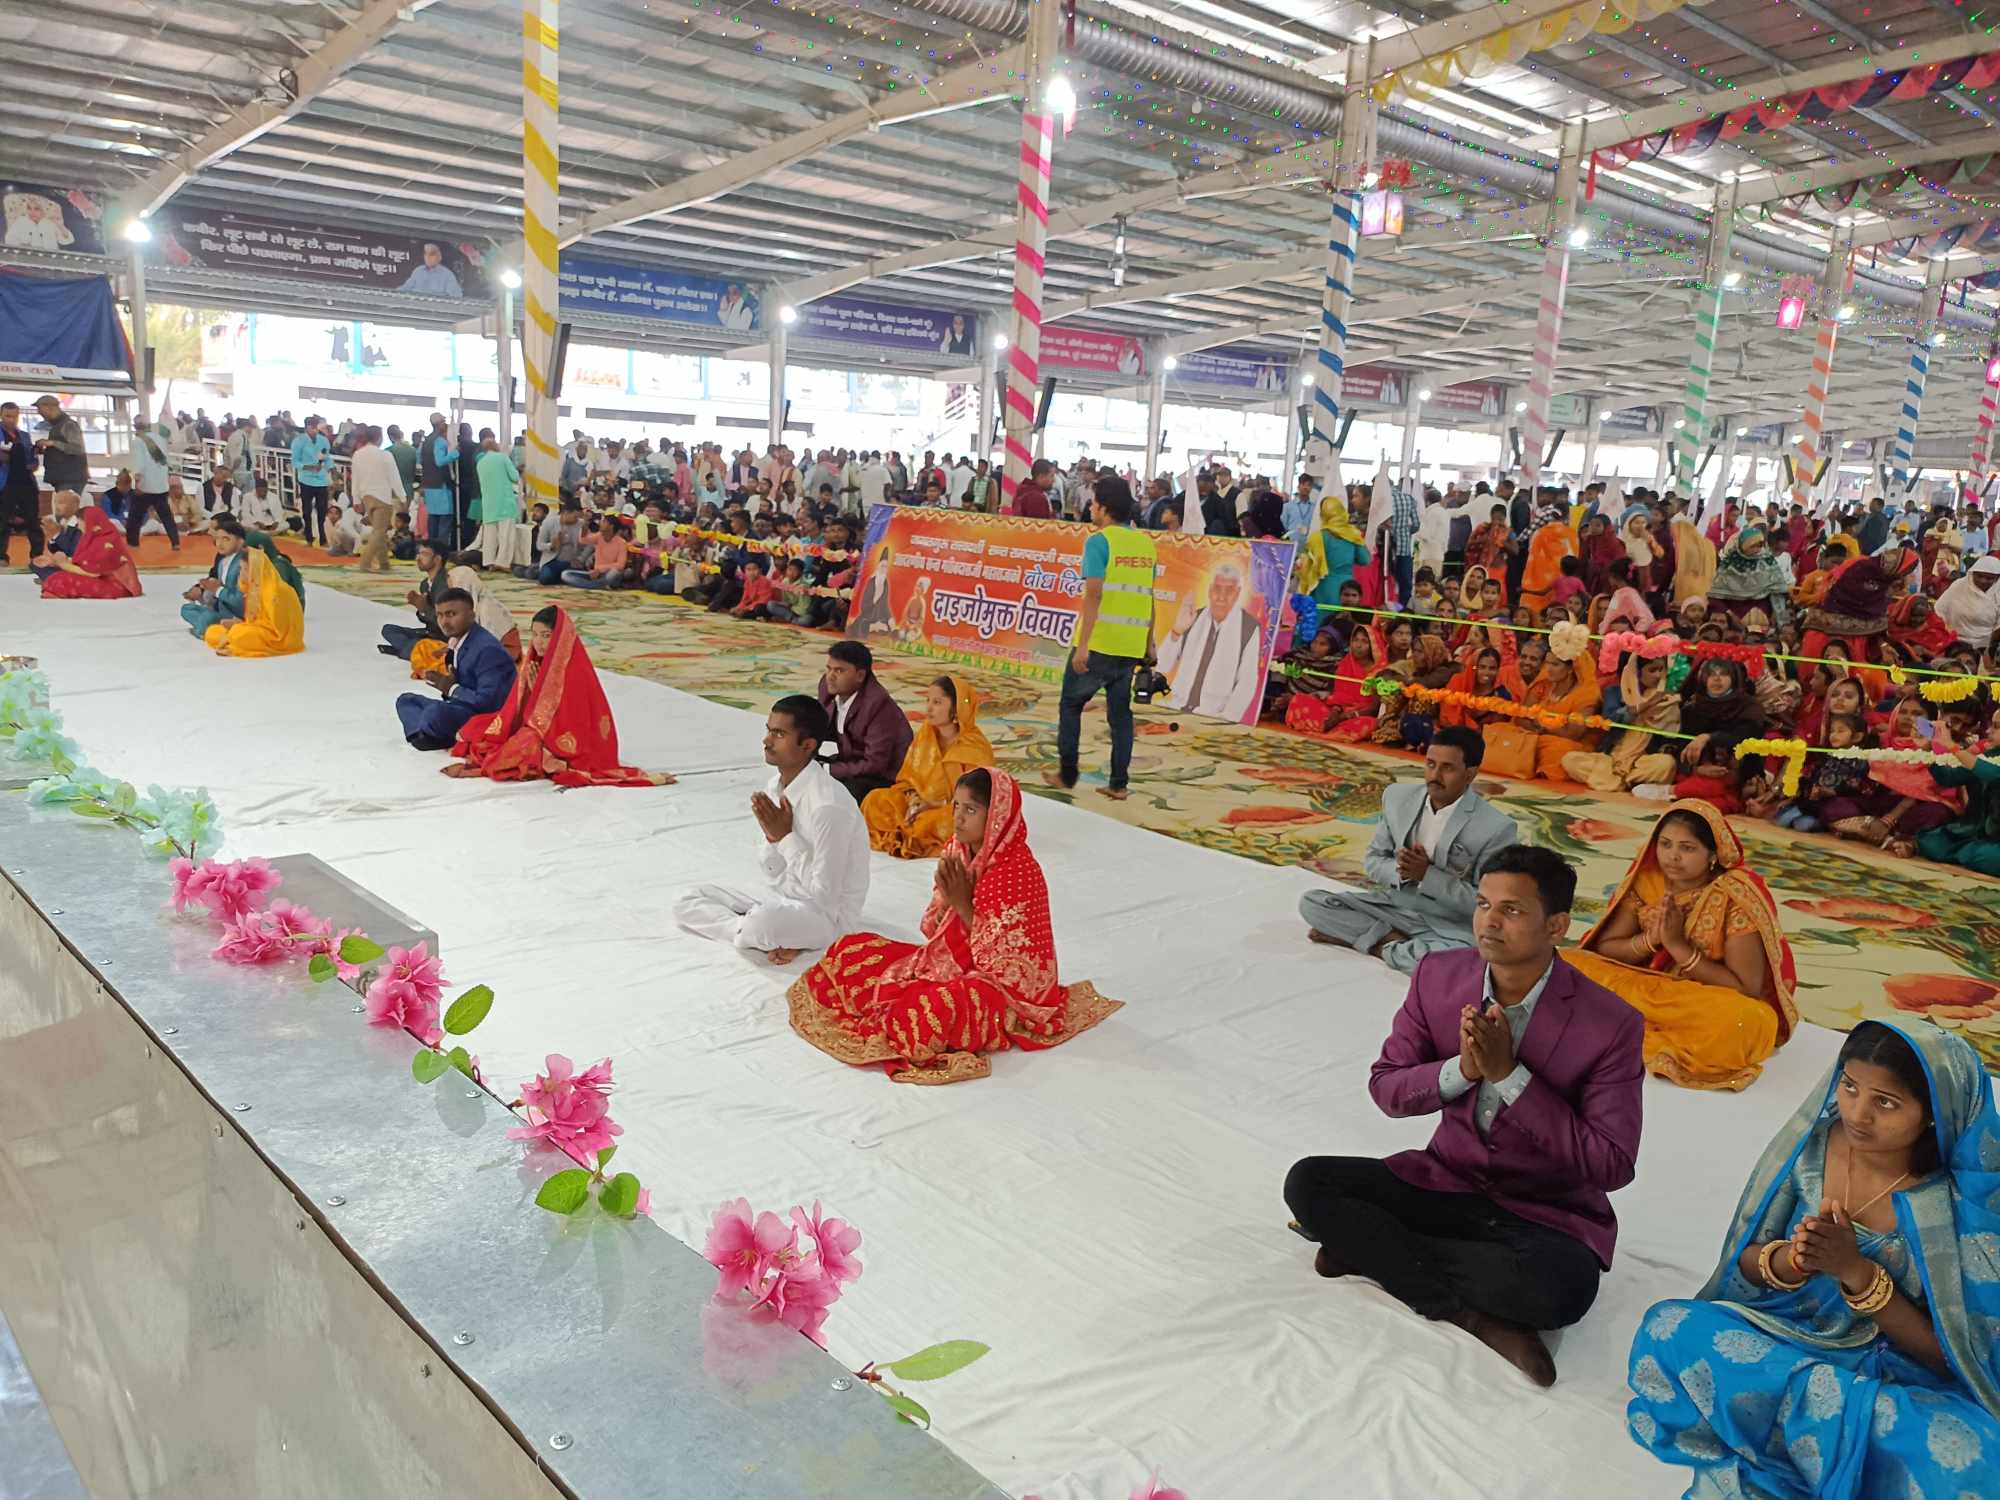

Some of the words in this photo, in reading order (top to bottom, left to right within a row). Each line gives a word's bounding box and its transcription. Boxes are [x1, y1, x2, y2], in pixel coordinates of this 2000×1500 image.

[1115, 556, 1152, 568] PRESS
[932, 585, 1018, 639] दाइजोमुक्त
[1018, 593, 1079, 647] विवाह
